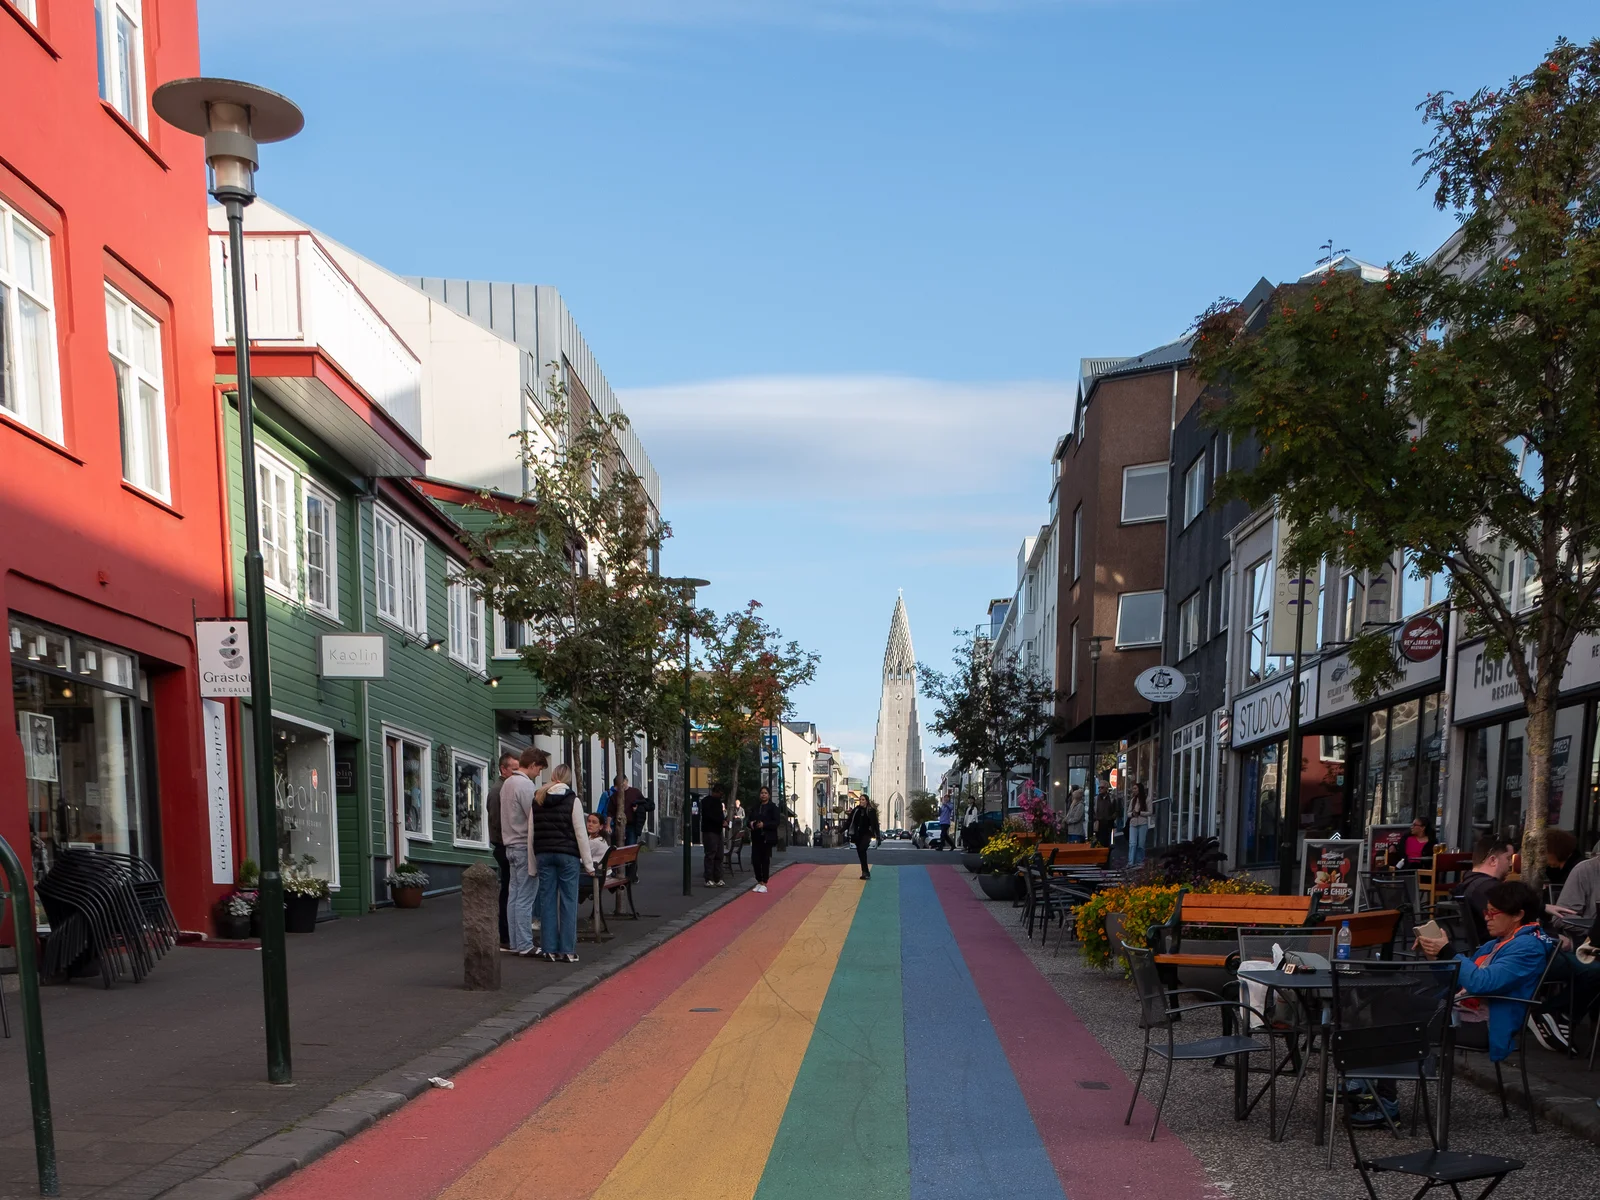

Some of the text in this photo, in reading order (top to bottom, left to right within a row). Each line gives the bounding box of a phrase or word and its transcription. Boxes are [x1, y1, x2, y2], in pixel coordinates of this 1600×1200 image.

[329, 648, 378, 661] Kaolin
[203, 671, 252, 683] Gráste
[1240, 691, 1283, 740] STUDIO
[213, 715, 223, 780] Gallery
[274, 768, 329, 815] Kaolin
[1331, 888, 1353, 896] CHIPS
